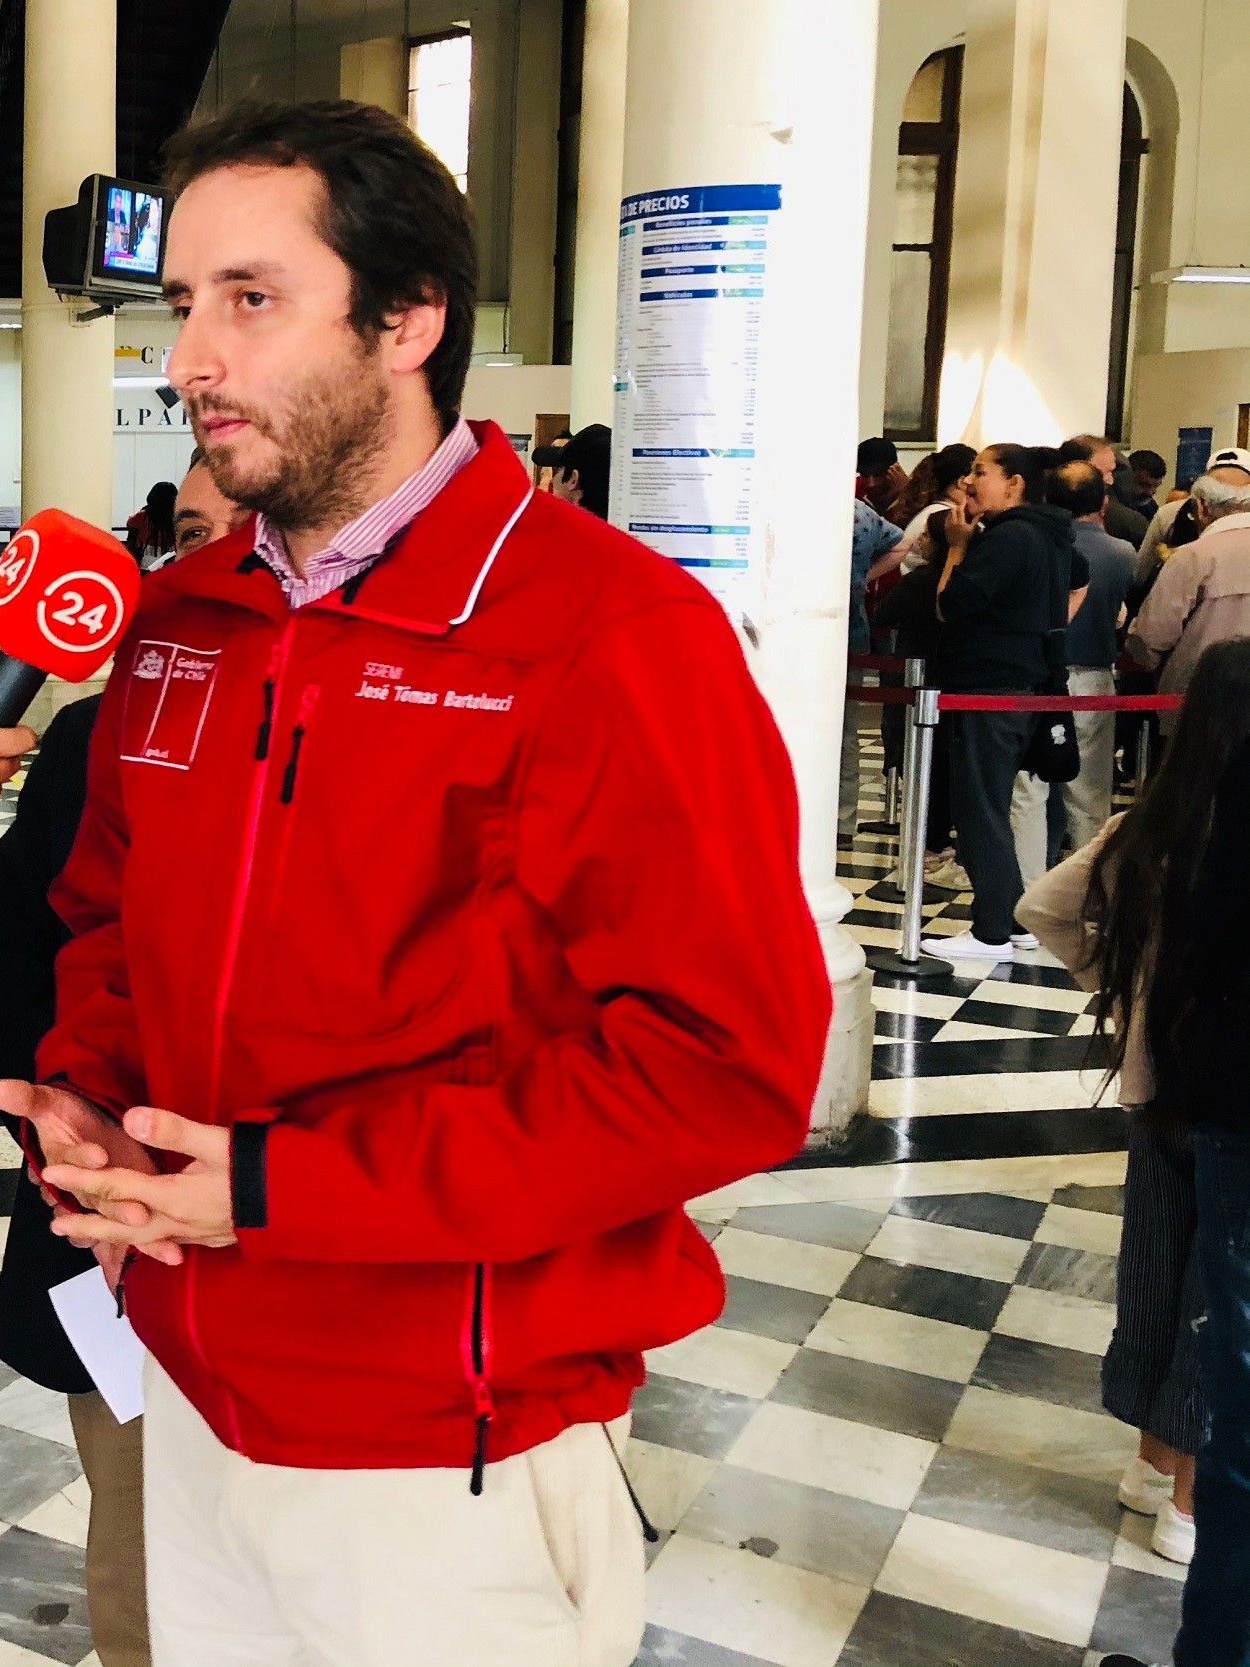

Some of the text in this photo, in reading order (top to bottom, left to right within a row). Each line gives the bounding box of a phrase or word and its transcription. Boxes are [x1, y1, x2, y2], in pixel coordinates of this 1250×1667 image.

[639, 194, 690, 214] PRECIOS
[51, 591, 108, 635] 24
[354, 680, 391, 701] José
[443, 690, 515, 712] Bartolucci
